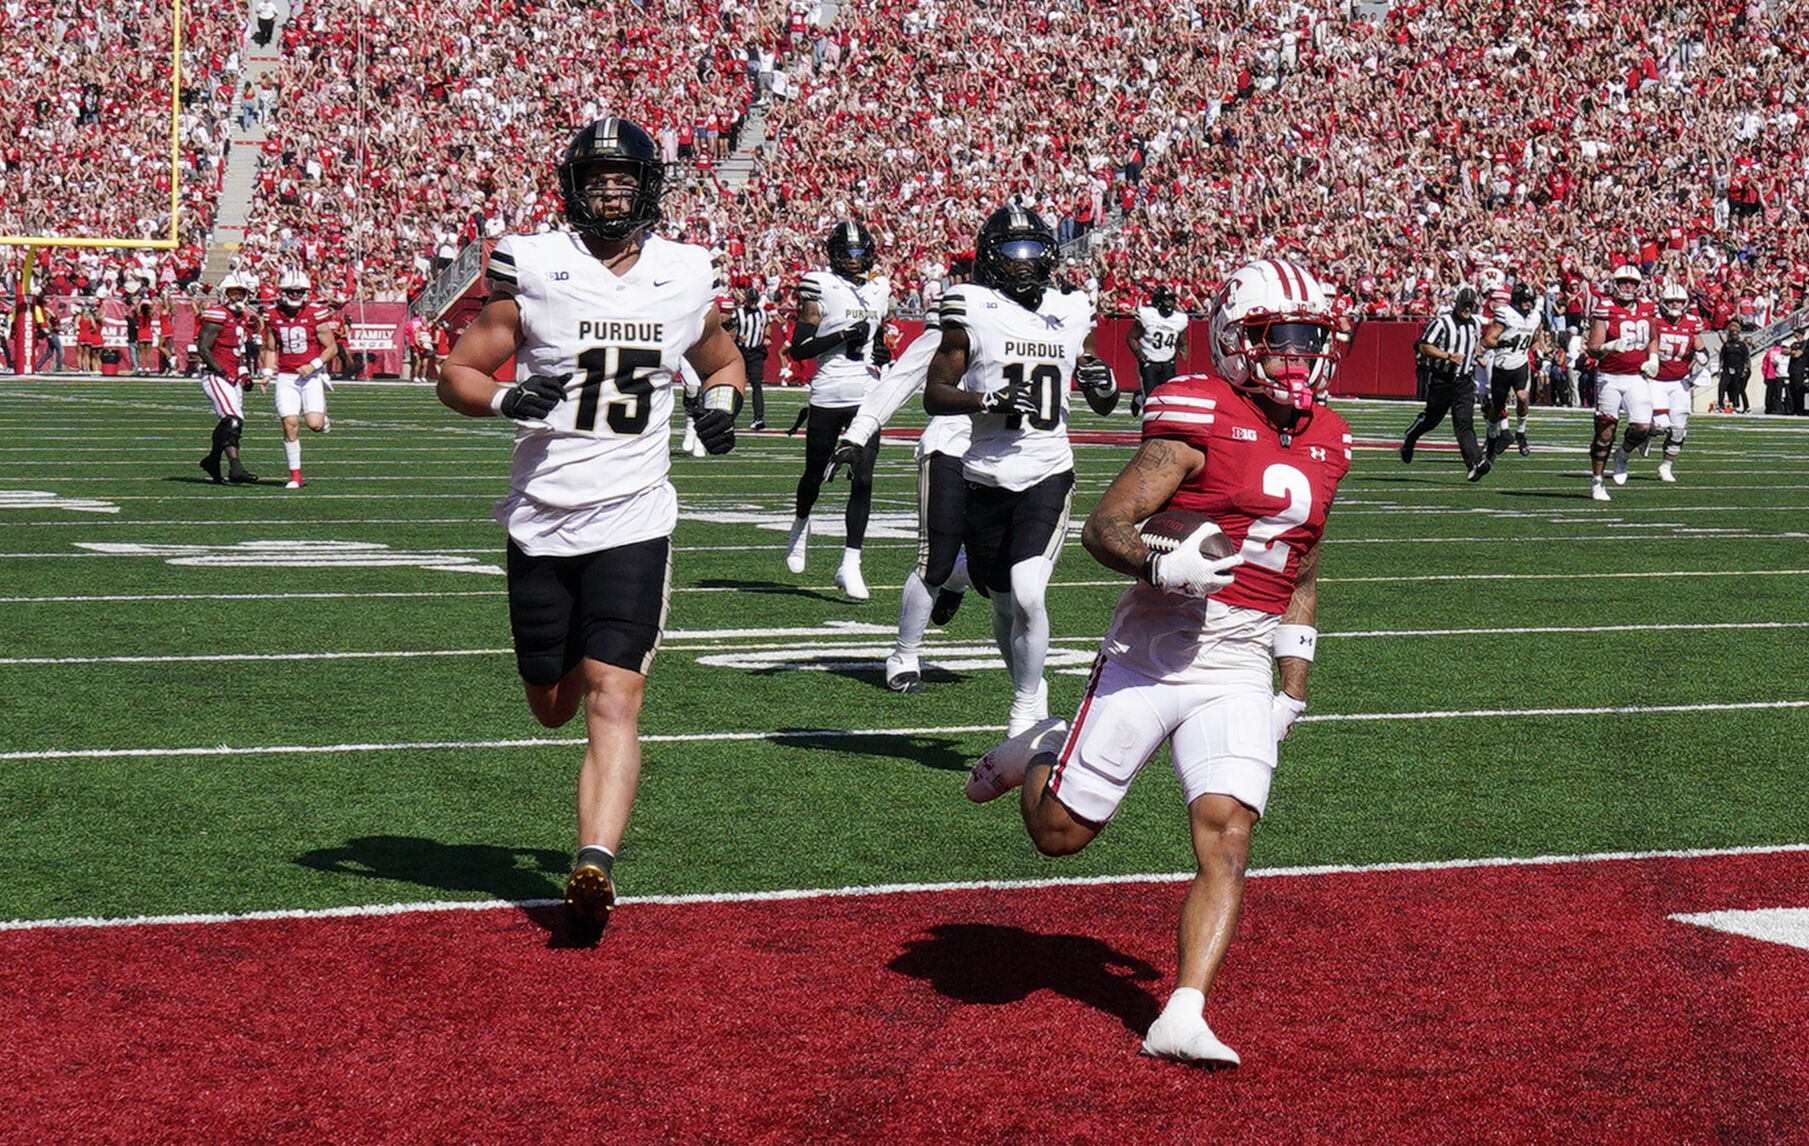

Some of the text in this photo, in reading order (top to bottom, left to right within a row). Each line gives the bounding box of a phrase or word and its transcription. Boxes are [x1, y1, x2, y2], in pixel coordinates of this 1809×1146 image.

[355, 330, 394, 339] FAMILY
[579, 321, 663, 342] PURDUE
[1152, 331, 1174, 349] 34
[1620, 320, 1650, 351] 60
[1004, 341, 1065, 358] PURDUE
[1659, 333, 1690, 361] 57
[575, 346, 663, 434] 15
[1002, 363, 1061, 431] 10
[1239, 463, 1312, 573] 2
